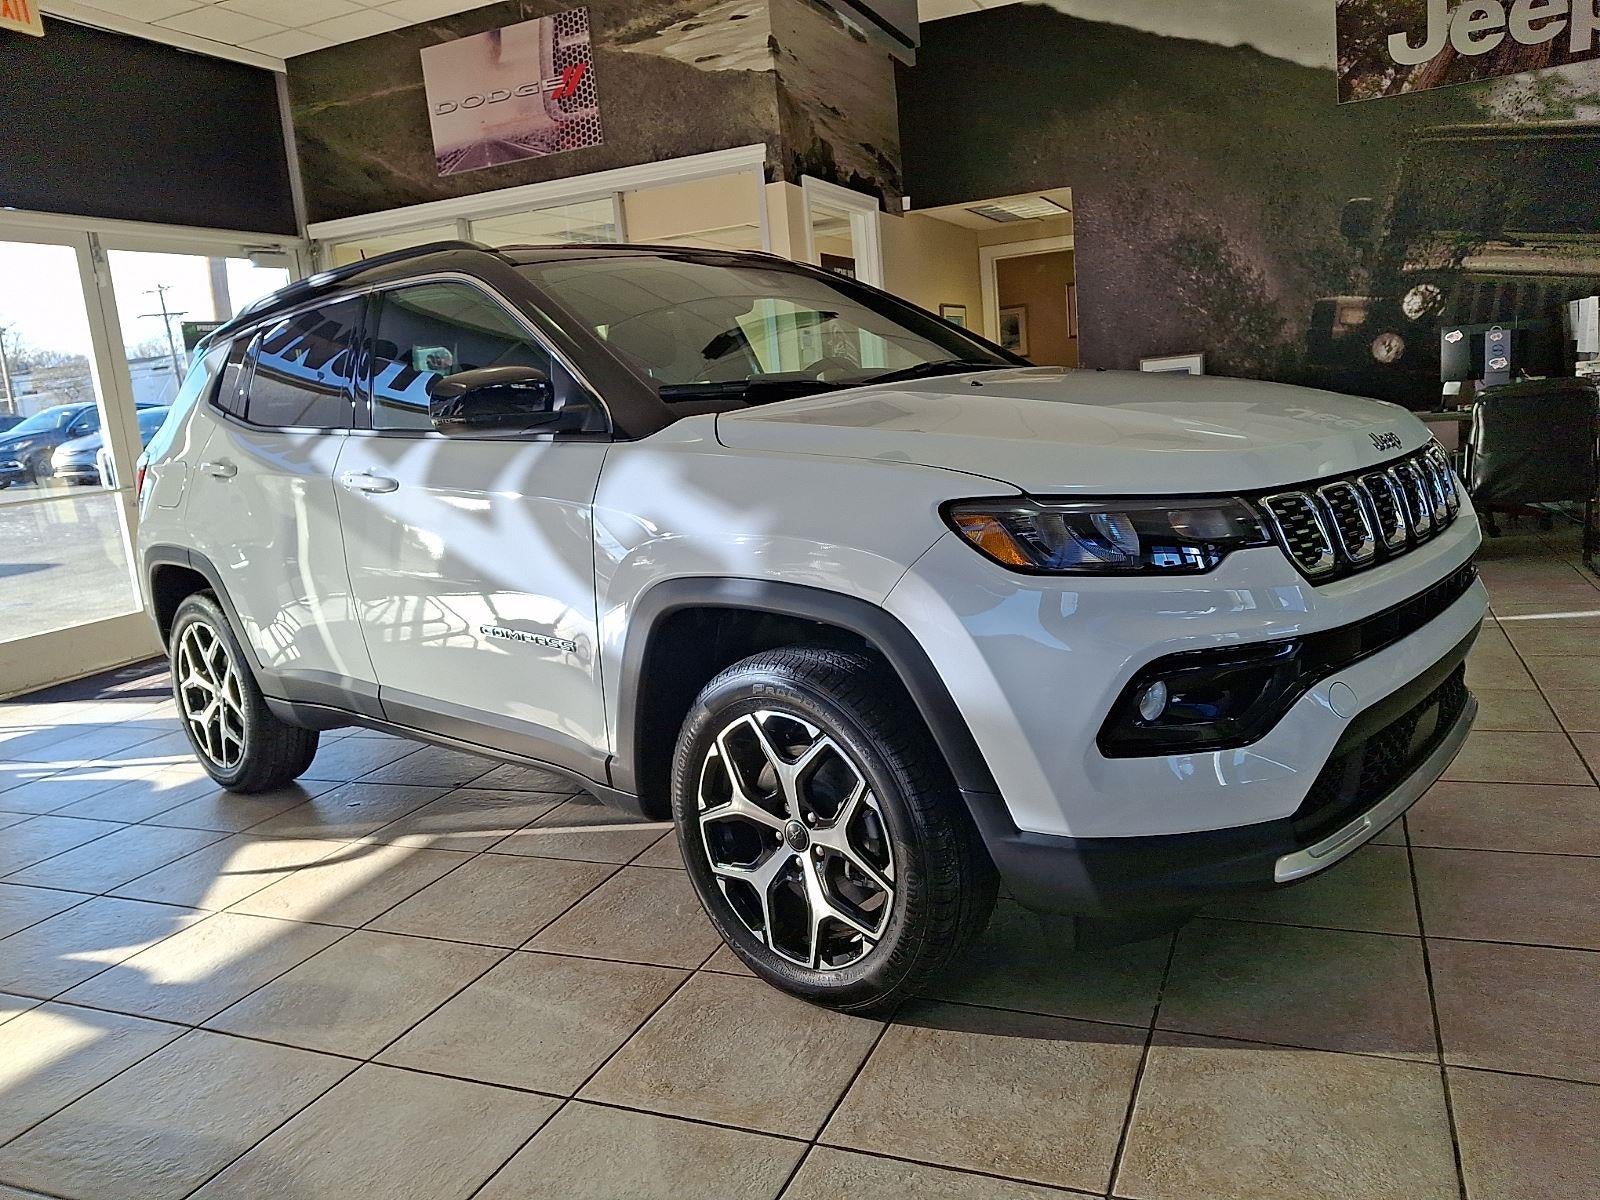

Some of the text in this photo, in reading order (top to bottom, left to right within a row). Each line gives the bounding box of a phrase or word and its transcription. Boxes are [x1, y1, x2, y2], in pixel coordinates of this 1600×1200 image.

[434, 76, 565, 115] DODGE
[1368, 432, 1402, 451] Jeep
[480, 624, 577, 652] COMPASS
